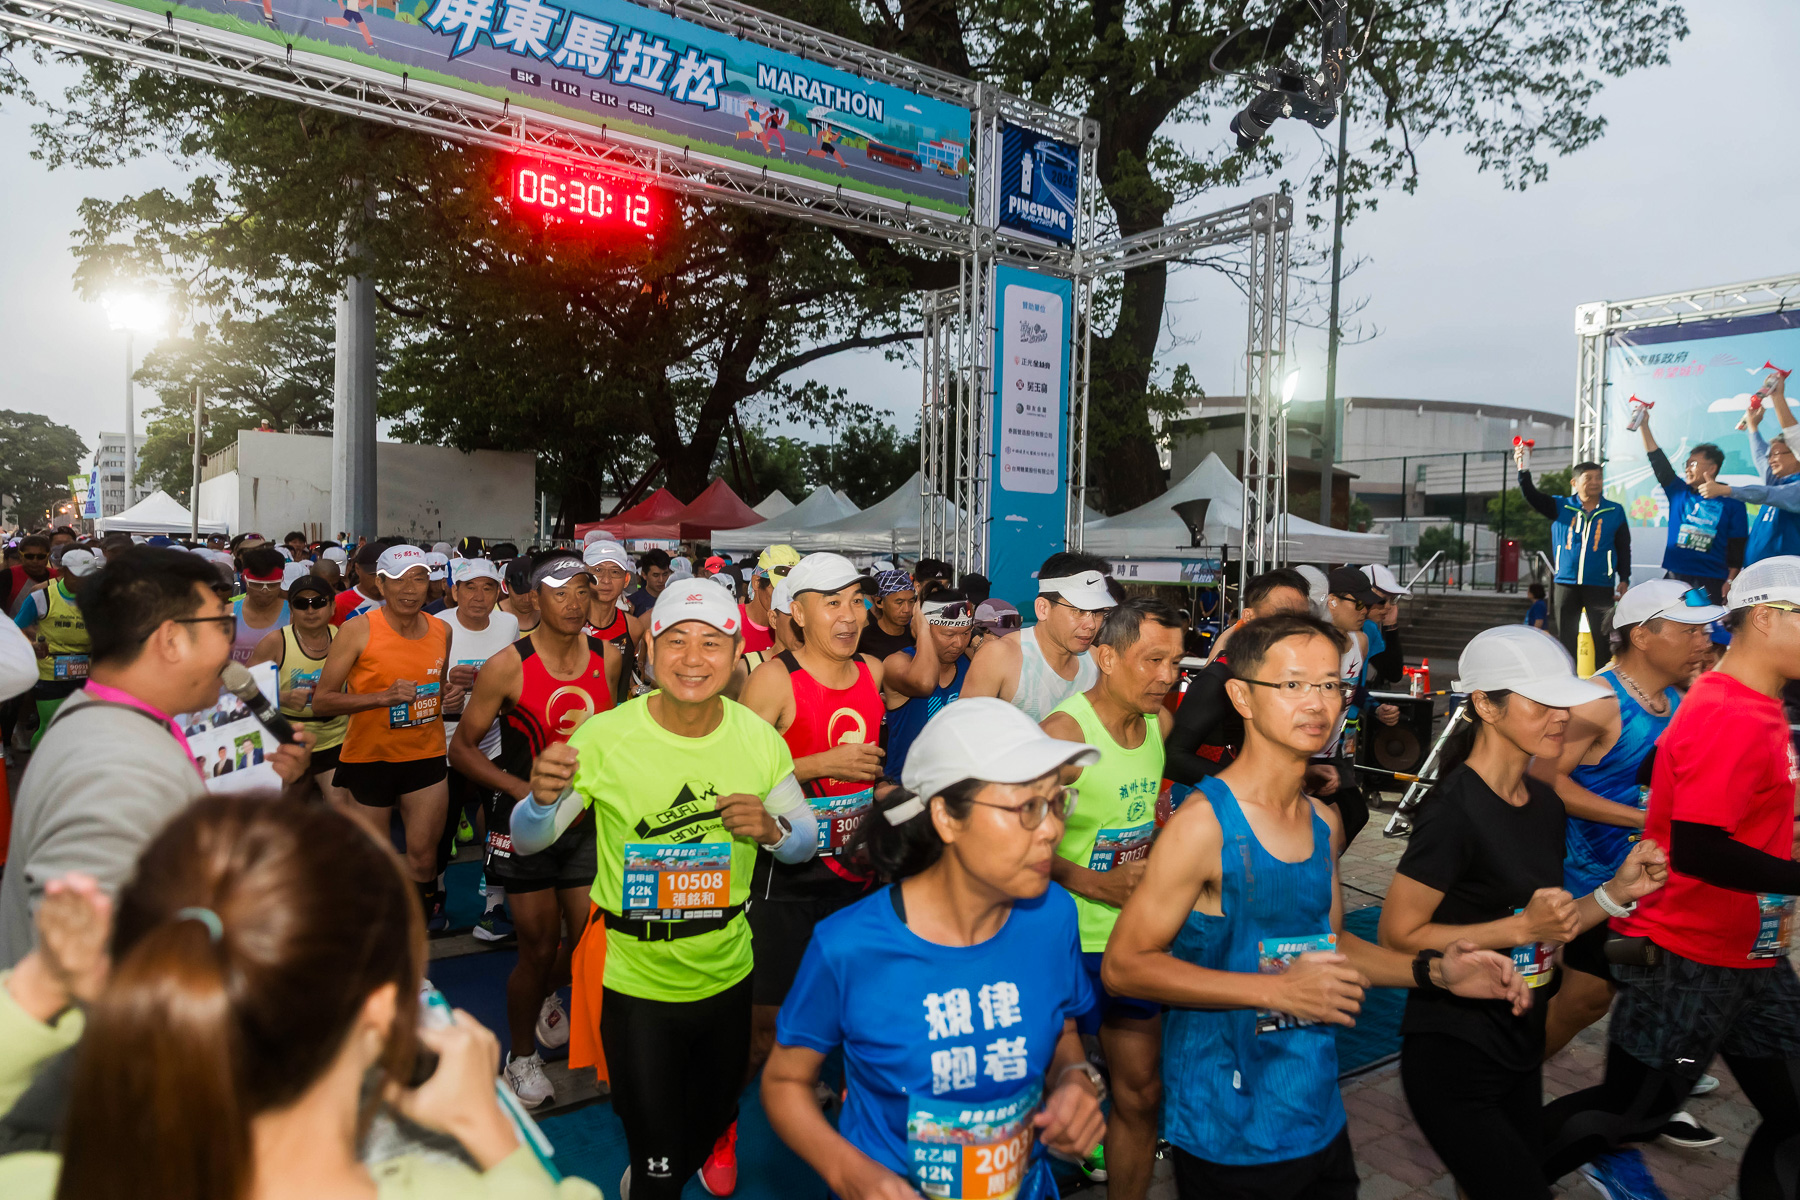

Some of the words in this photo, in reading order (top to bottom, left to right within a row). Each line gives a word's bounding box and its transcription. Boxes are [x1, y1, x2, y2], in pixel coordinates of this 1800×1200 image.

[425, 0, 727, 108] 屏東馬拉松
[516, 70, 535, 84] 5K
[553, 81, 578, 97] 11K
[591, 90, 617, 107] 21K
[629, 101, 653, 116] 42K
[757, 63, 884, 123] MARATHON
[1051, 170, 1074, 189] 2025
[1008, 194, 1067, 230] PINGTUNG
[413, 697, 438, 711] 10503
[1090, 862, 1108, 871] 21K
[626, 874, 655, 884] 男甲組
[666, 872, 724, 891] 10508
[628, 885, 653, 896] 42K
[672, 892, 715, 907] 張銘和
[1513, 953, 1531, 965] 21K
[923, 980, 1023, 1041] 規律
[930, 1036, 1029, 1096] 跑者
[913, 1147, 957, 1164] 女乙組
[916, 1165, 954, 1182] 42K
